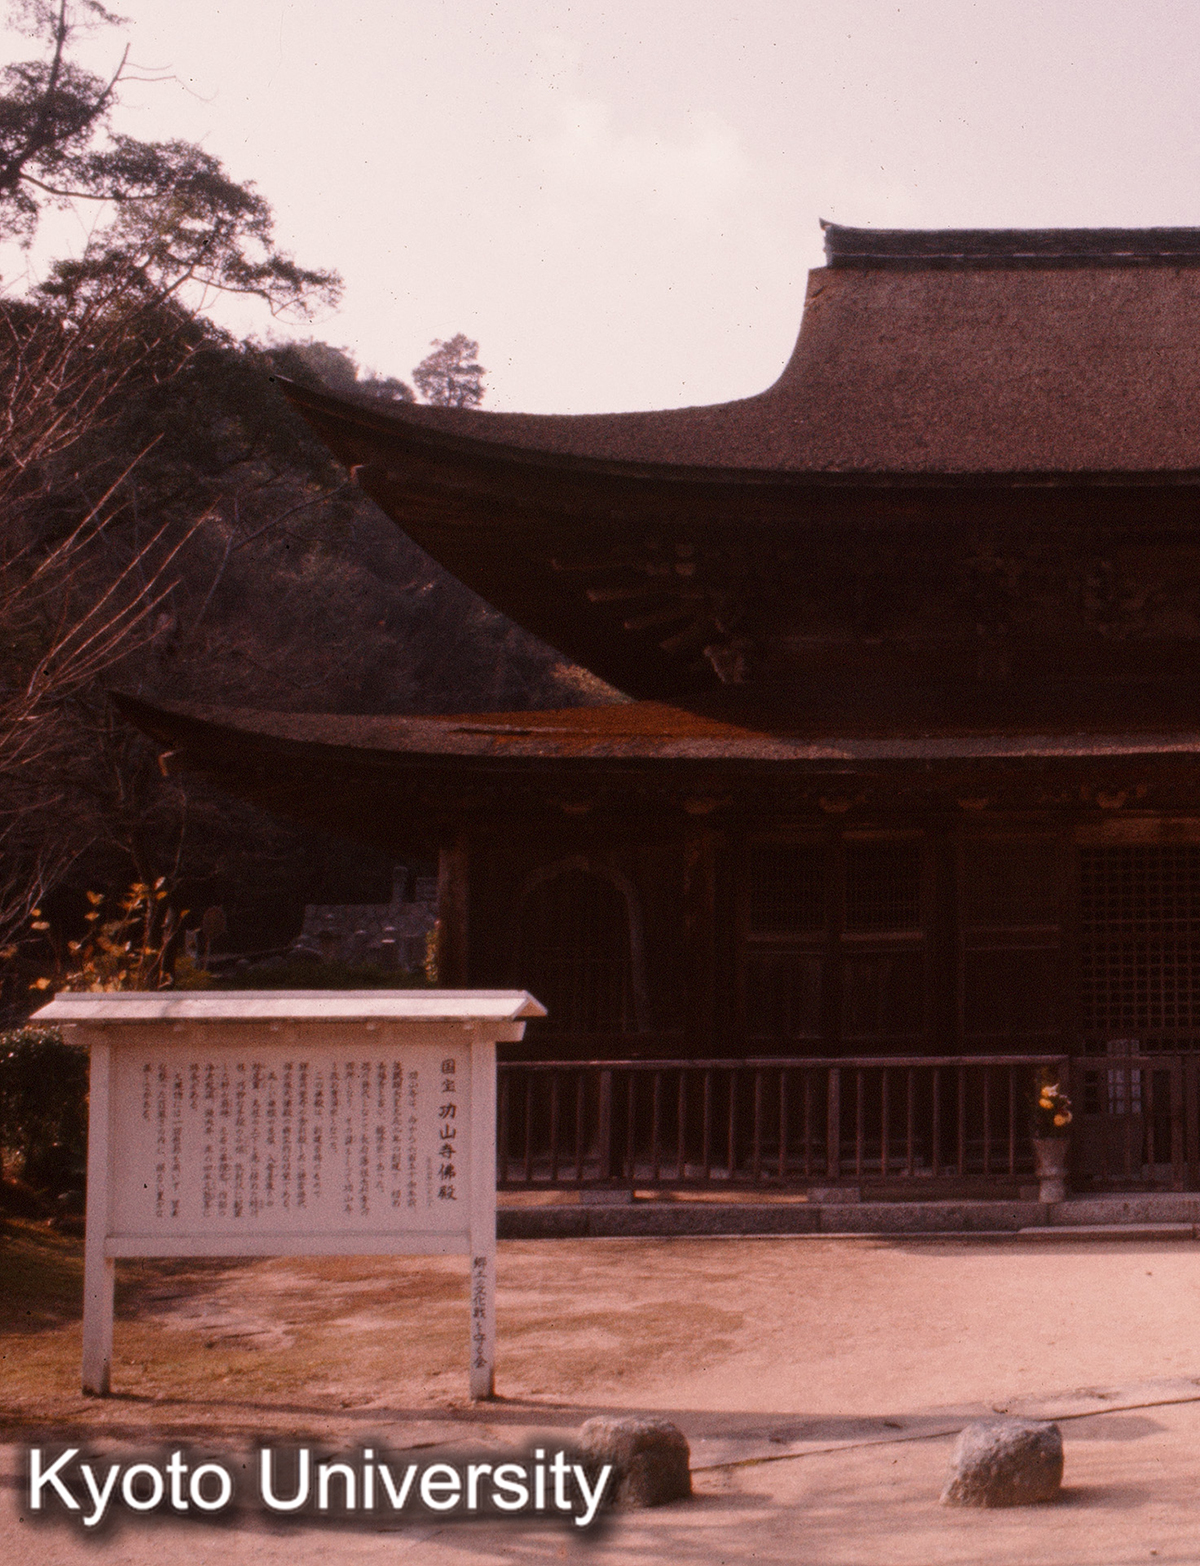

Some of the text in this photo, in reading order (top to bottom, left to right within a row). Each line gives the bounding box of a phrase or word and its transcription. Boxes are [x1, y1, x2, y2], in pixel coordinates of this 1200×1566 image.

[438, 1058, 457, 1201] 国宝 功山寺佛殿
[473, 1256, 487, 1369] 郷土の文化財を守る会
